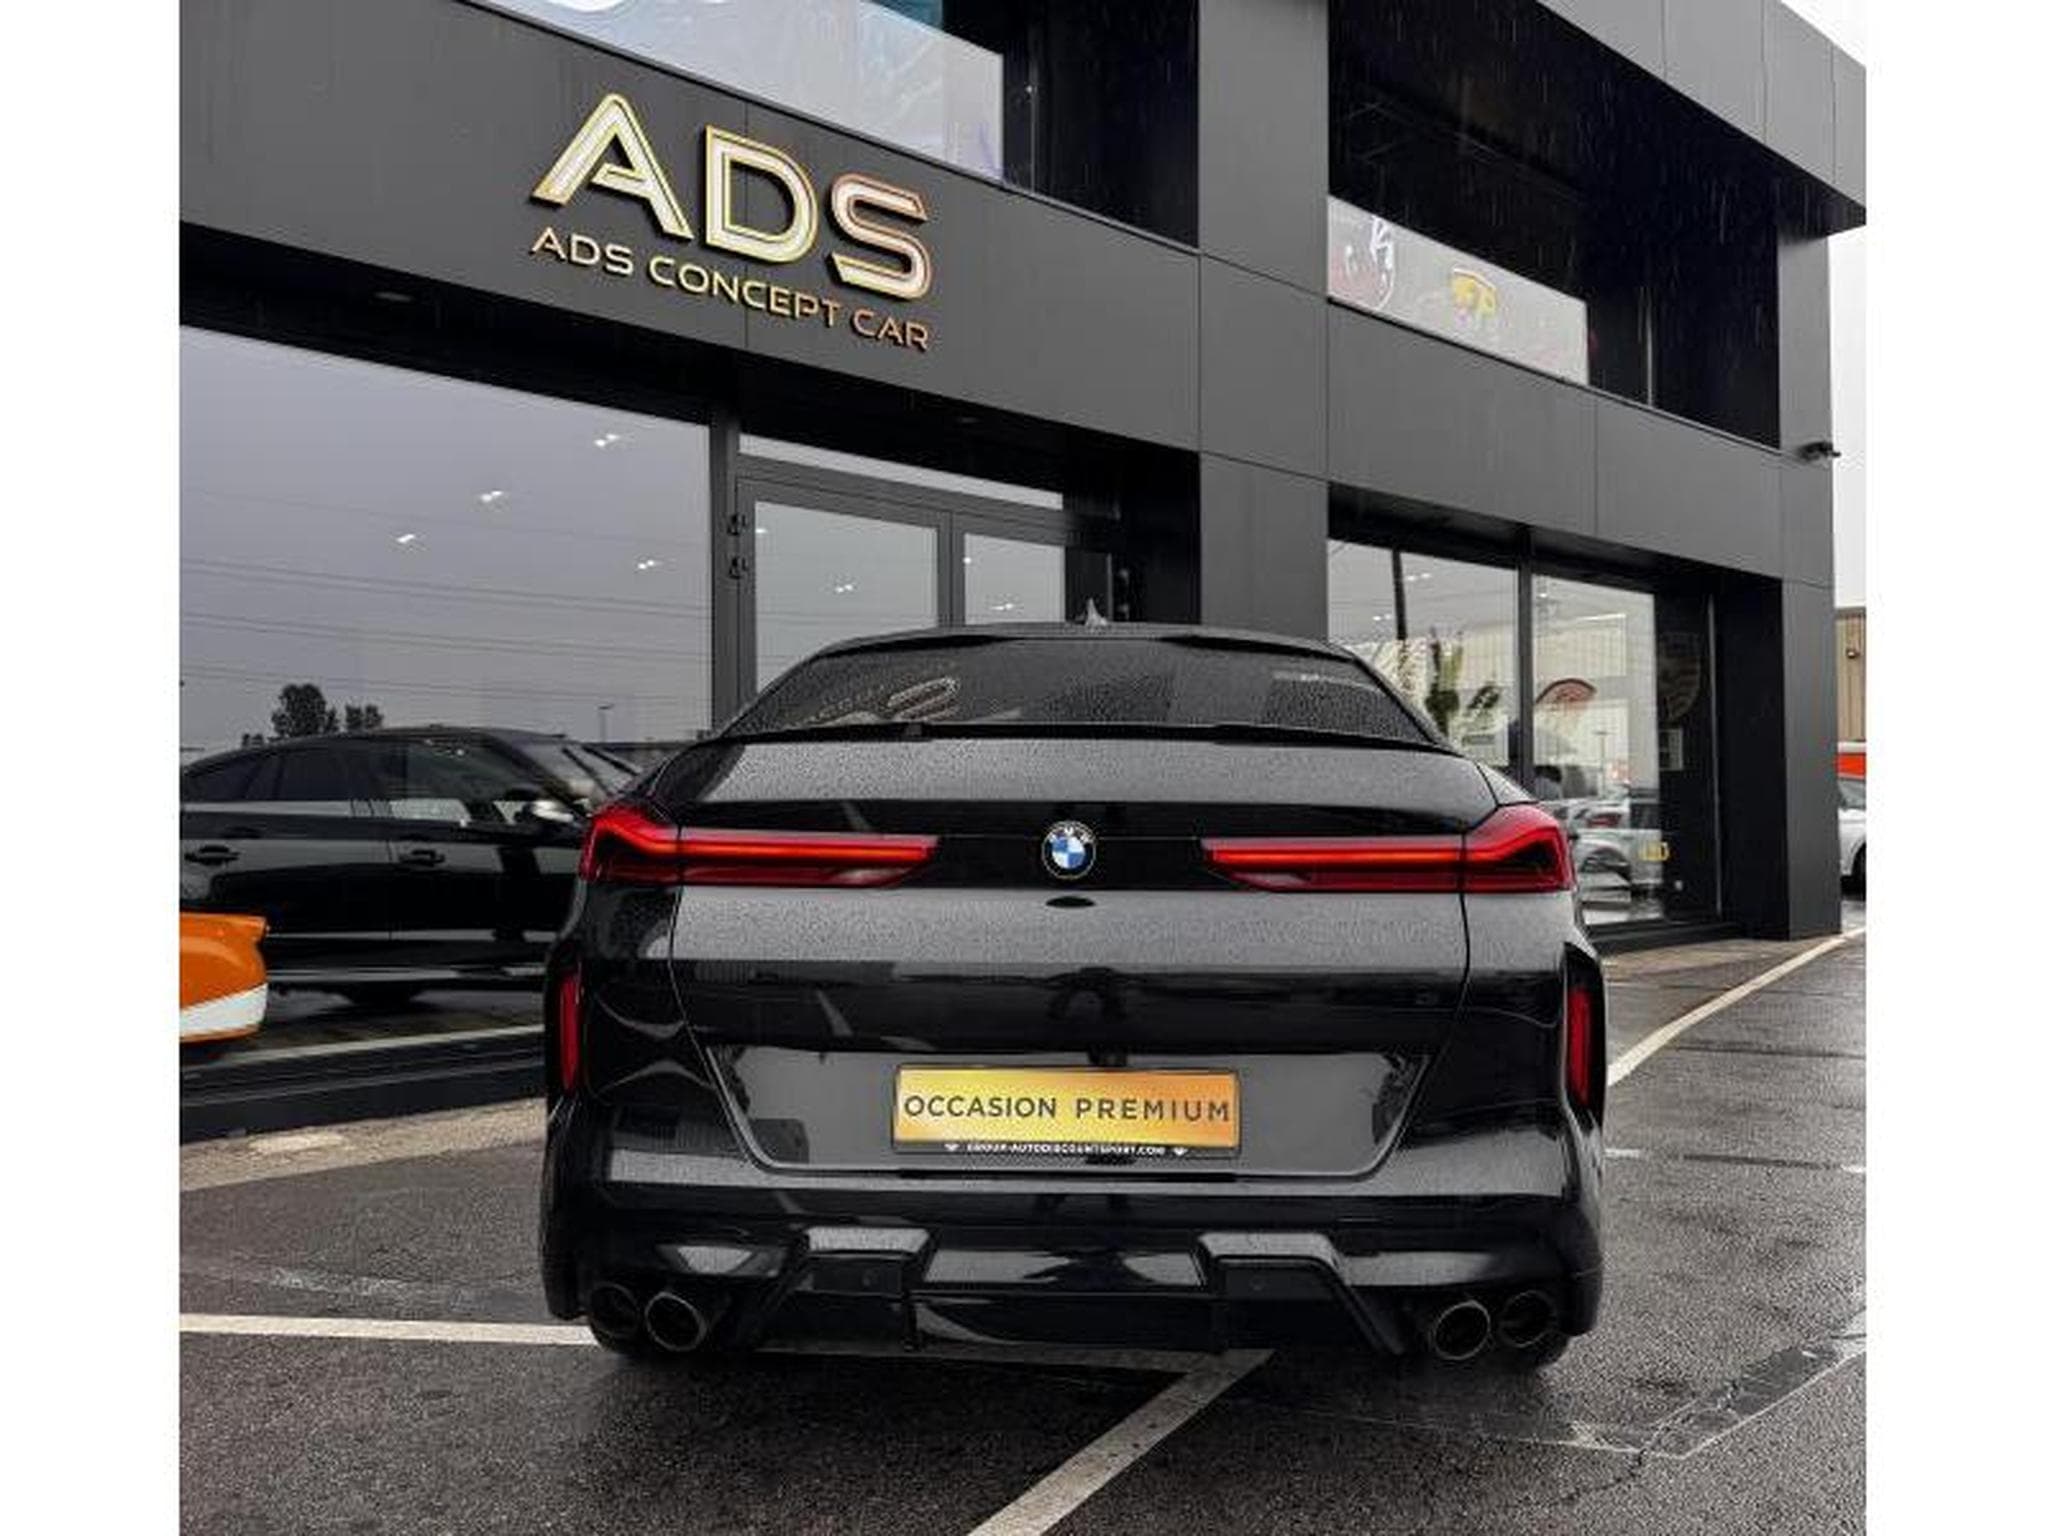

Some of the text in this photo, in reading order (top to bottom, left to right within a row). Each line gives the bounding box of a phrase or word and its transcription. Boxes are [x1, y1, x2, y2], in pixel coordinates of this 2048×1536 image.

[532, 93, 931, 301] ADS
[531, 226, 931, 351] ADS CONCEPT CAR
[904, 1095, 1230, 1122] OCCASION PREMIUM
